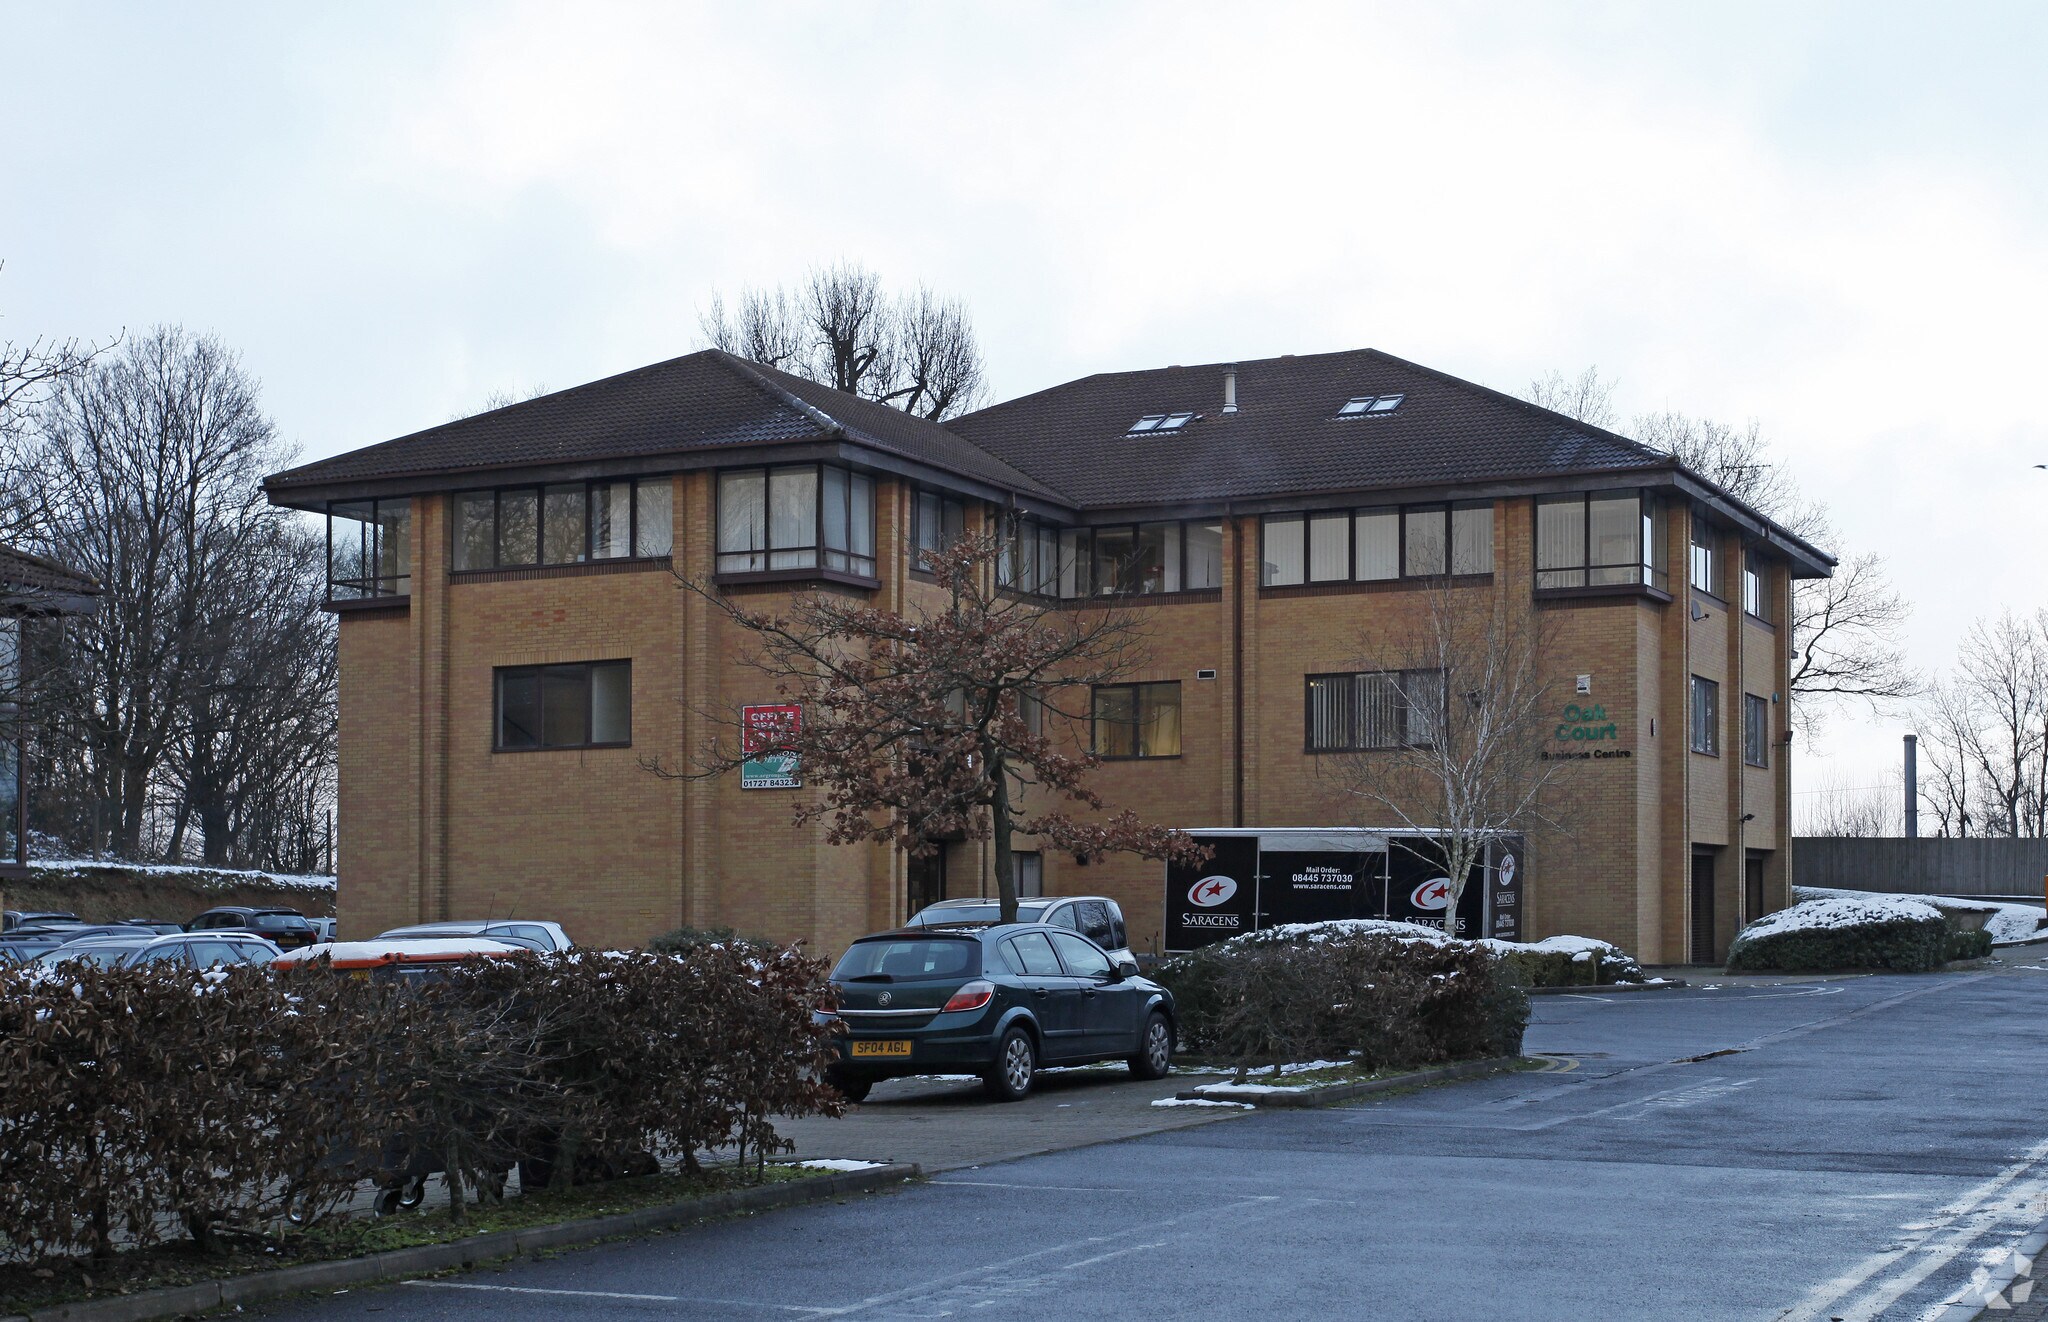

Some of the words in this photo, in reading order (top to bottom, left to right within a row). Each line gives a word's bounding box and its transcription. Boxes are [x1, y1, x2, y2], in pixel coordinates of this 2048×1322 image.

[1564, 703, 1608, 722] Oak
[1555, 722, 1617, 741] Court
[1541, 750, 1591, 760] Business
[1594, 749, 1631, 759] Centre
[743, 780, 768, 788] 01727
[1306, 866, 1320, 874] Mail
[1320, 866, 1341, 874] Order:
[1292, 873, 1319, 882] 08445
[1320, 874, 1353, 883] 737030
[1182, 912, 1240, 926] SARACENS
[857, 1042, 885, 1053] SF04
[886, 1042, 907, 1053] AGL
